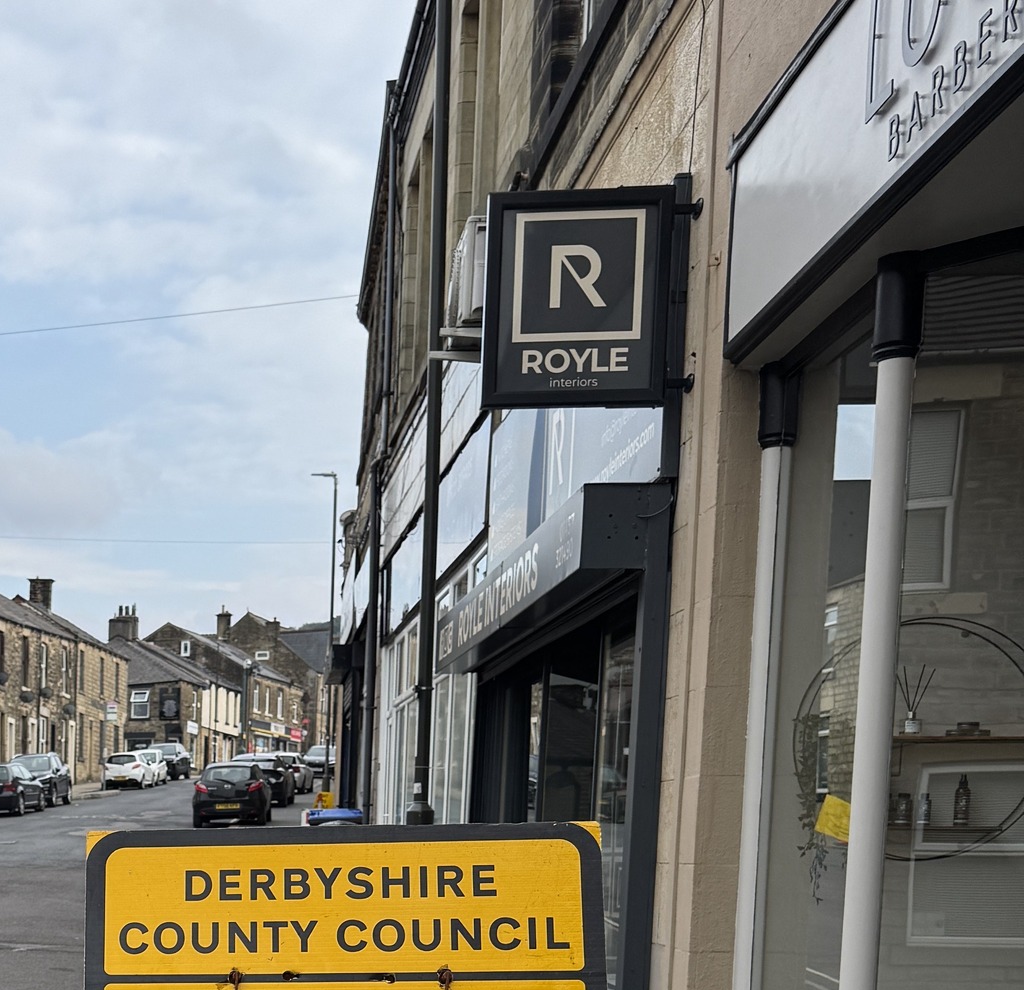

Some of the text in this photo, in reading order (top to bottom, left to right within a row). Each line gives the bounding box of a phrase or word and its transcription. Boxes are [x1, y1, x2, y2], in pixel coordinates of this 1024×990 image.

[549, 244, 607, 309] R
[521, 347, 629, 374] ROYLE
[549, 377, 598, 388] interiors
[458, 592, 484, 647] ROYLE
[484, 543, 539, 627] INTERIORS
[185, 865, 497, 901] DERBYSHIRE
[119, 917, 570, 955] COUNTY COUNCIL
